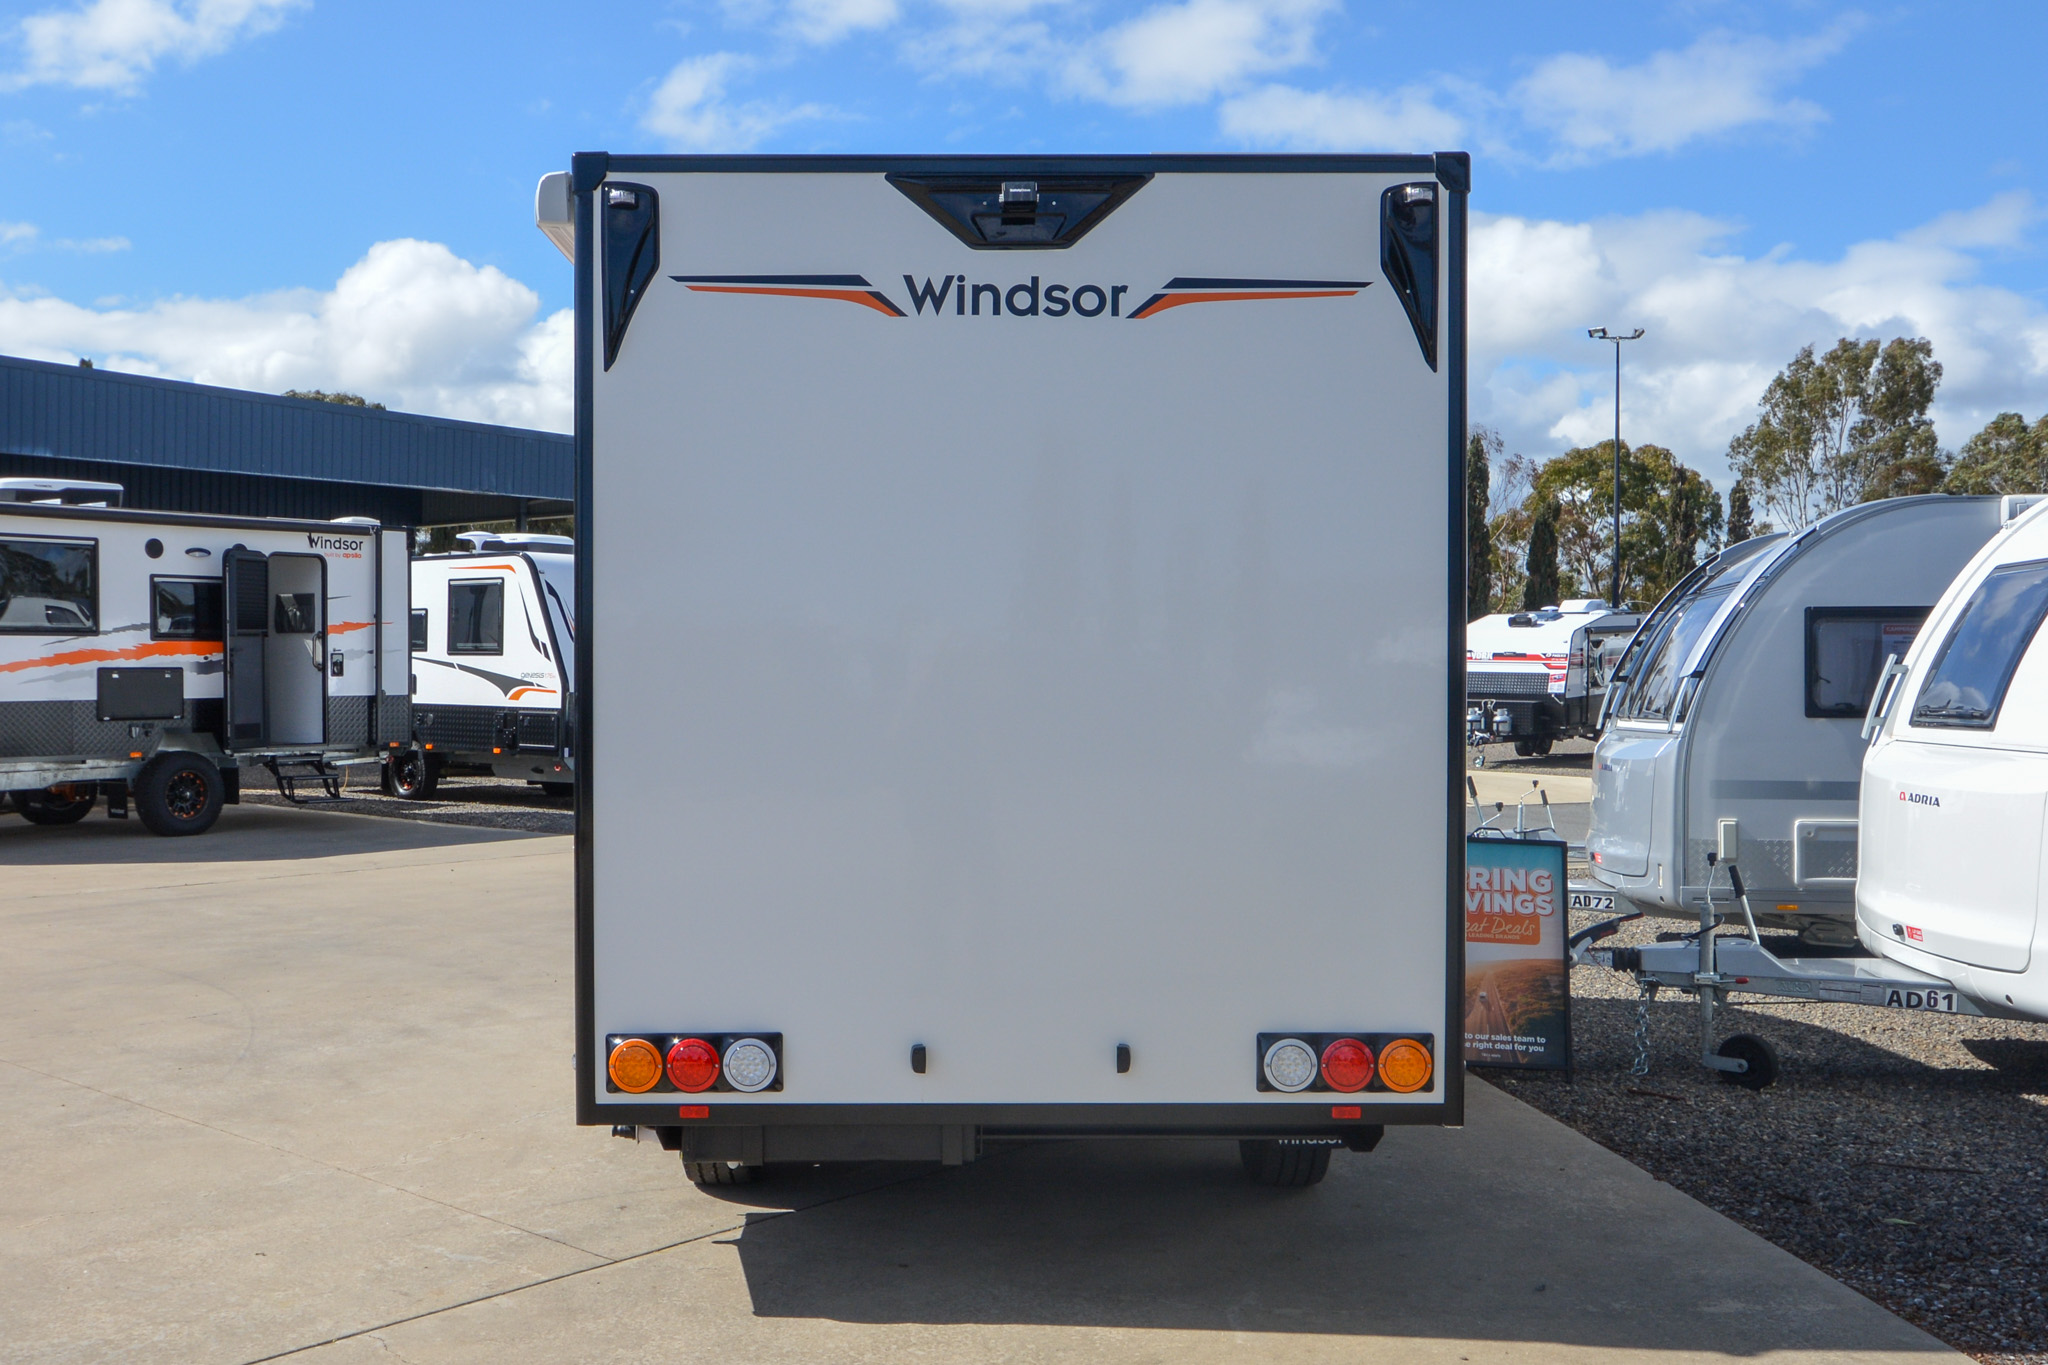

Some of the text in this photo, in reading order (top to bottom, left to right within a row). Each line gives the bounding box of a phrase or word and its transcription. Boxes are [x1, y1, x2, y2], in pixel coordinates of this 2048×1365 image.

[902, 274, 1129, 318] Windsor
[307, 533, 364, 551] Windsor
[1907, 792, 1941, 807] ADRIA
[1467, 866, 1554, 895] RING
[1572, 895, 1614, 909] AD72
[1491, 917, 1536, 936] Deals
[1886, 990, 1954, 1011] AD61
[1472, 1041, 1493, 1050] right
[1494, 1042, 1513, 1050] deal
[1514, 1043, 1527, 1052] for
[1528, 1045, 1544, 1053] you
[1491, 1034, 1512, 1042] sales
[1513, 1034, 1535, 1043] team
[1537, 1036, 1546, 1044] to
